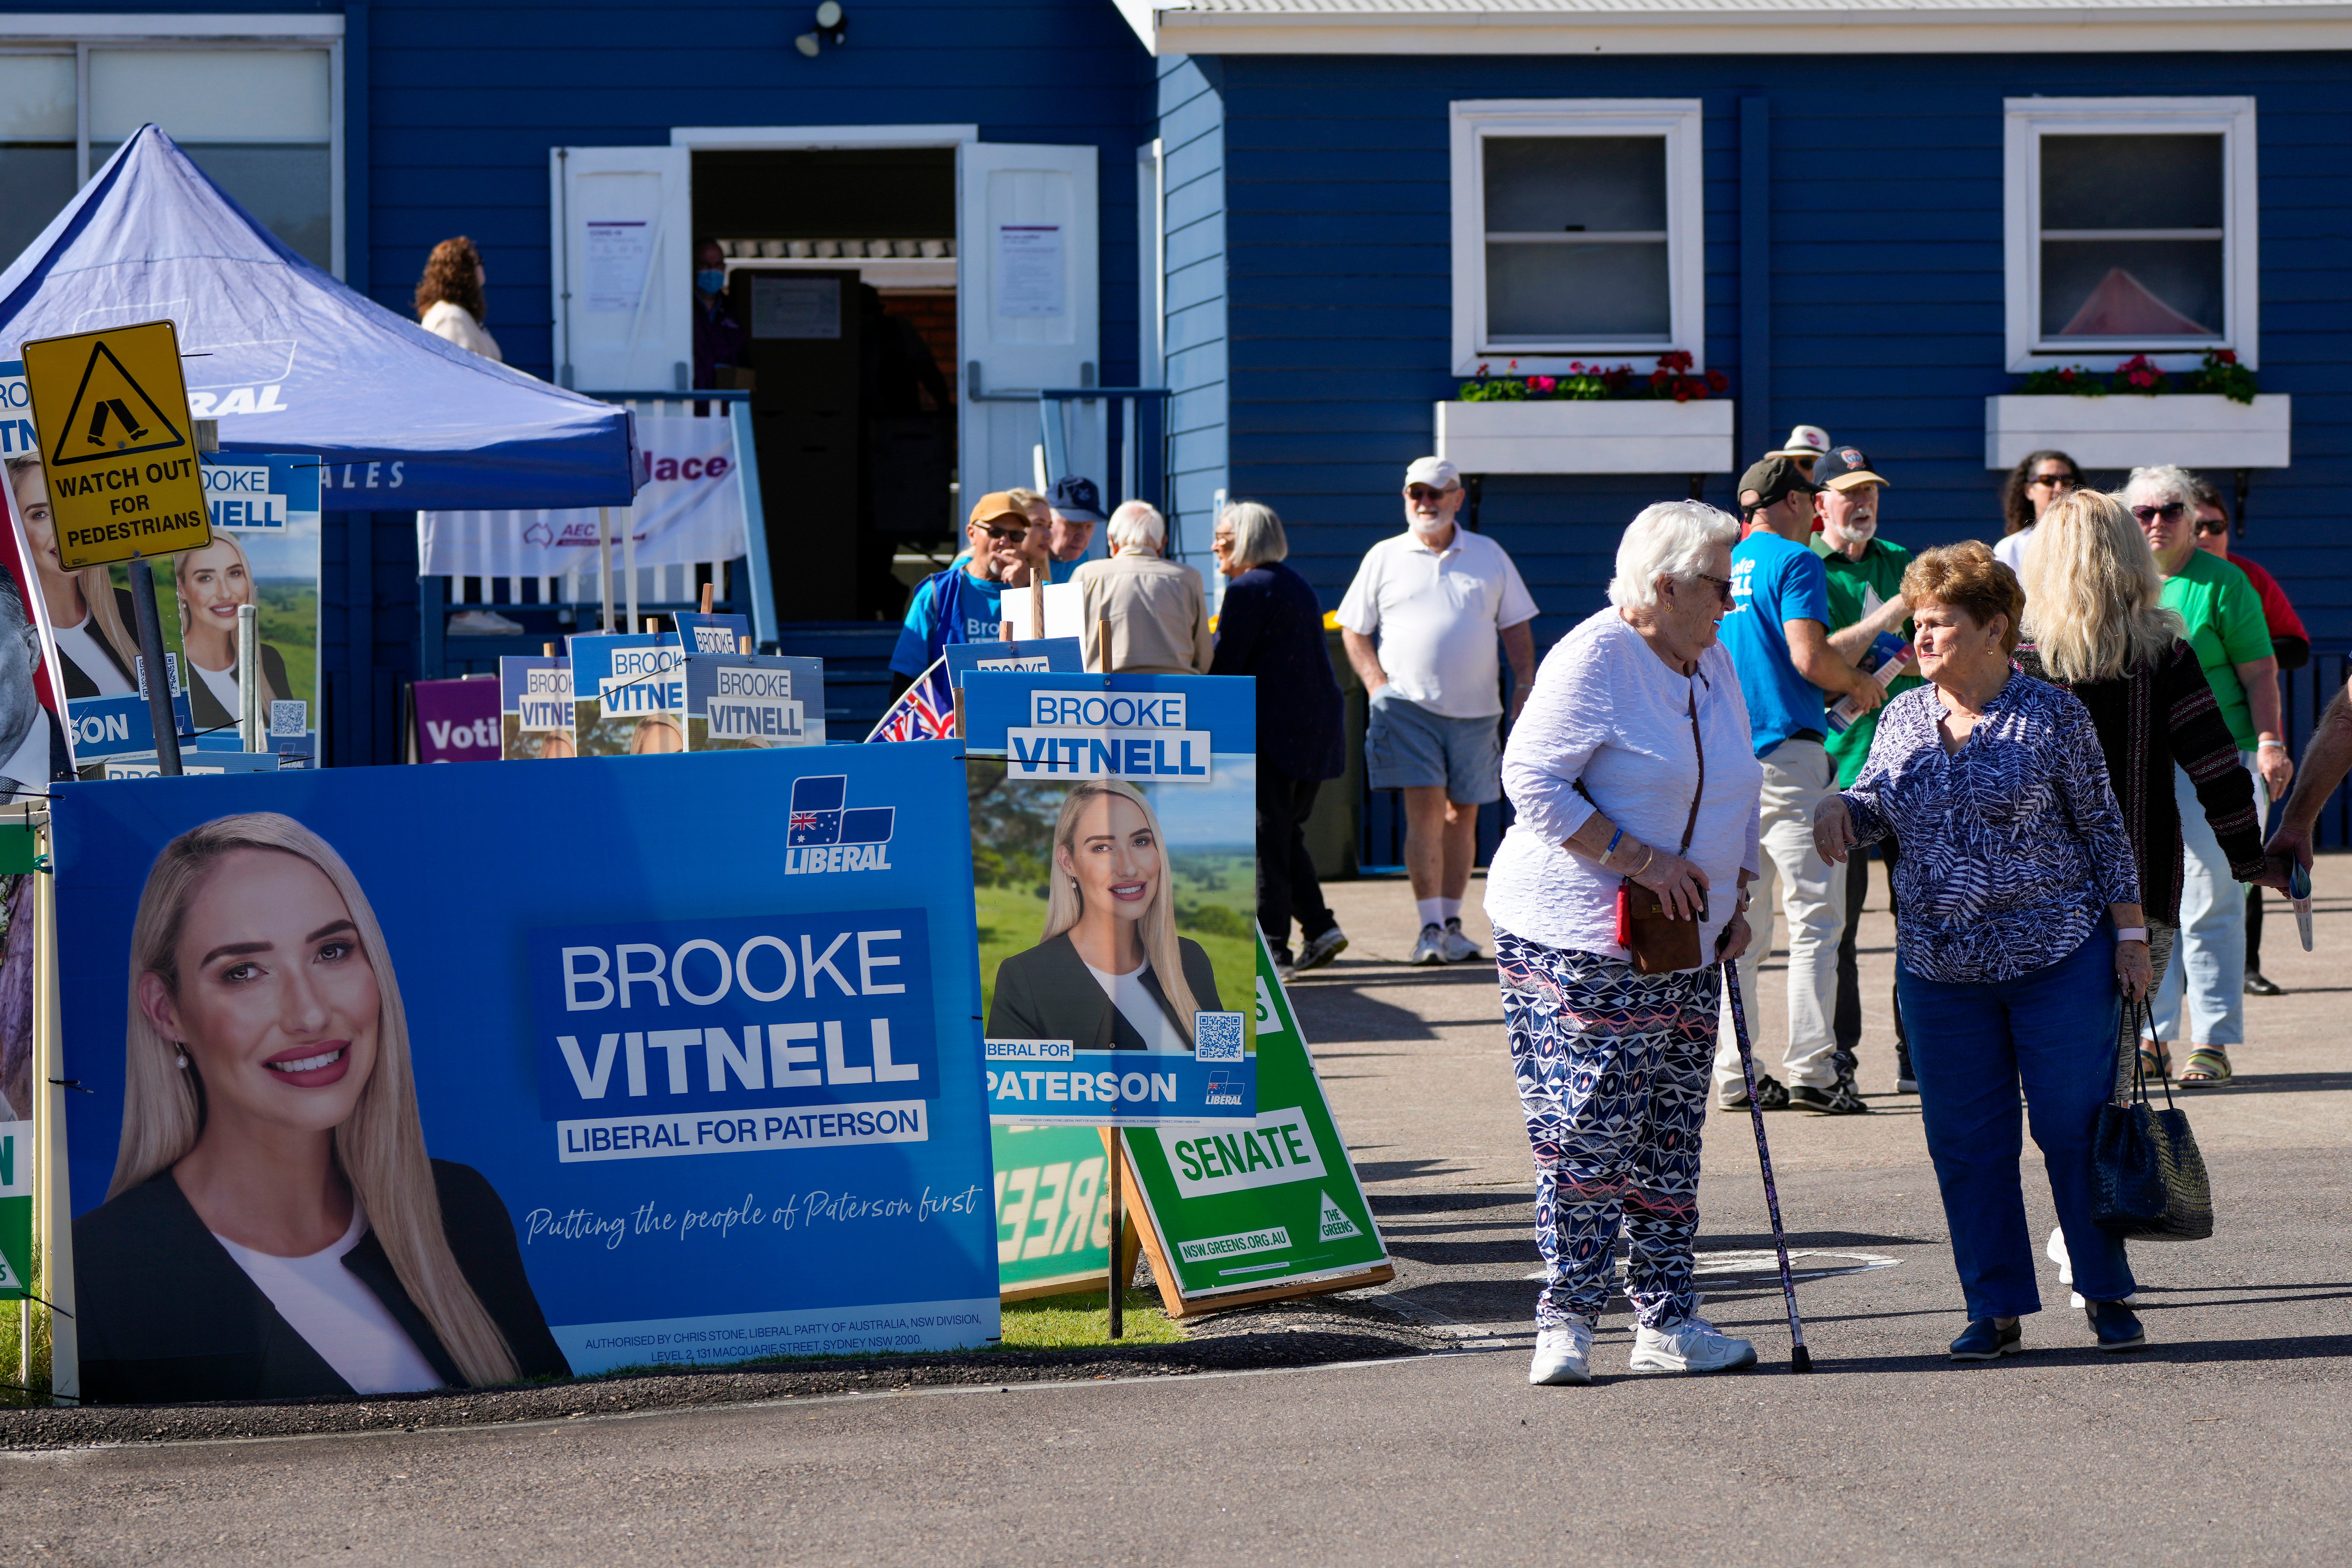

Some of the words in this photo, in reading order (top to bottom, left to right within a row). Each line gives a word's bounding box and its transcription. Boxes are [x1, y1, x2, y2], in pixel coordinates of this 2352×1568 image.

[55, 467, 139, 498] WATCH
[146, 458, 192, 483] OUT
[110, 495, 150, 515] FOR
[67, 511, 201, 547] PEDESTRIANS
[561, 524, 595, 536] AEC
[967, 618, 1000, 635] Bro
[696, 632, 735, 654] BROOKE
[603, 682, 682, 712] VITNE
[720, 673, 789, 697] BROOKE
[710, 704, 802, 736] VITNELL
[1037, 697, 1181, 727] BROOKE
[426, 716, 501, 750] Voti
[1012, 737, 1206, 775] VITNELL
[784, 844, 892, 875] LIBERAL
[562, 929, 906, 1012] BROOKE
[556, 1018, 920, 1100] VITNELL
[1040, 1044, 1070, 1057] FOR
[1205, 1095, 1242, 1105] LIBERAL
[567, 1121, 690, 1154] LIBERAL
[697, 1118, 757, 1144] FOR
[765, 1109, 918, 1140] PATERSON
[1175, 1123, 1312, 1181] SENATE
[525, 1208, 626, 1250] Putting
[632, 1201, 677, 1234] the
[681, 1193, 766, 1241] people
[772, 1194, 799, 1231] of
[802, 1190, 913, 1226] Paterson
[915, 1185, 984, 1222] first
[1322, 1220, 1353, 1236] GREENS
[1323, 1209, 1341, 1222] THE
[1183, 1231, 1286, 1258] NSW.GREENS.ORG.AU
[585, 1336, 656, 1350] AUTHORISED
[657, 1335, 673, 1345] BY
[673, 1332, 707, 1344] CHRIS
[708, 1330, 748, 1341] STONE,
[749, 1327, 792, 1339] LIBERAL
[794, 1324, 830, 1336] PARTY
[831, 1323, 847, 1333] OF
[848, 1318, 909, 1332] AUSTRALIA,
[910, 1317, 934, 1328] NSW
[936, 1314, 980, 1326] DIVISION,
[651, 1351, 684, 1362] LEVEL
[686, 1350, 694, 1360] 2,
[696, 1349, 711, 1359] 131
[713, 1345, 777, 1358] MACQUARIE
[779, 1341, 821, 1354] STREET,
[823, 1339, 865, 1350] SYDNEY
[868, 1336, 893, 1347] NSW
[895, 1335, 922, 1346] 2000.
